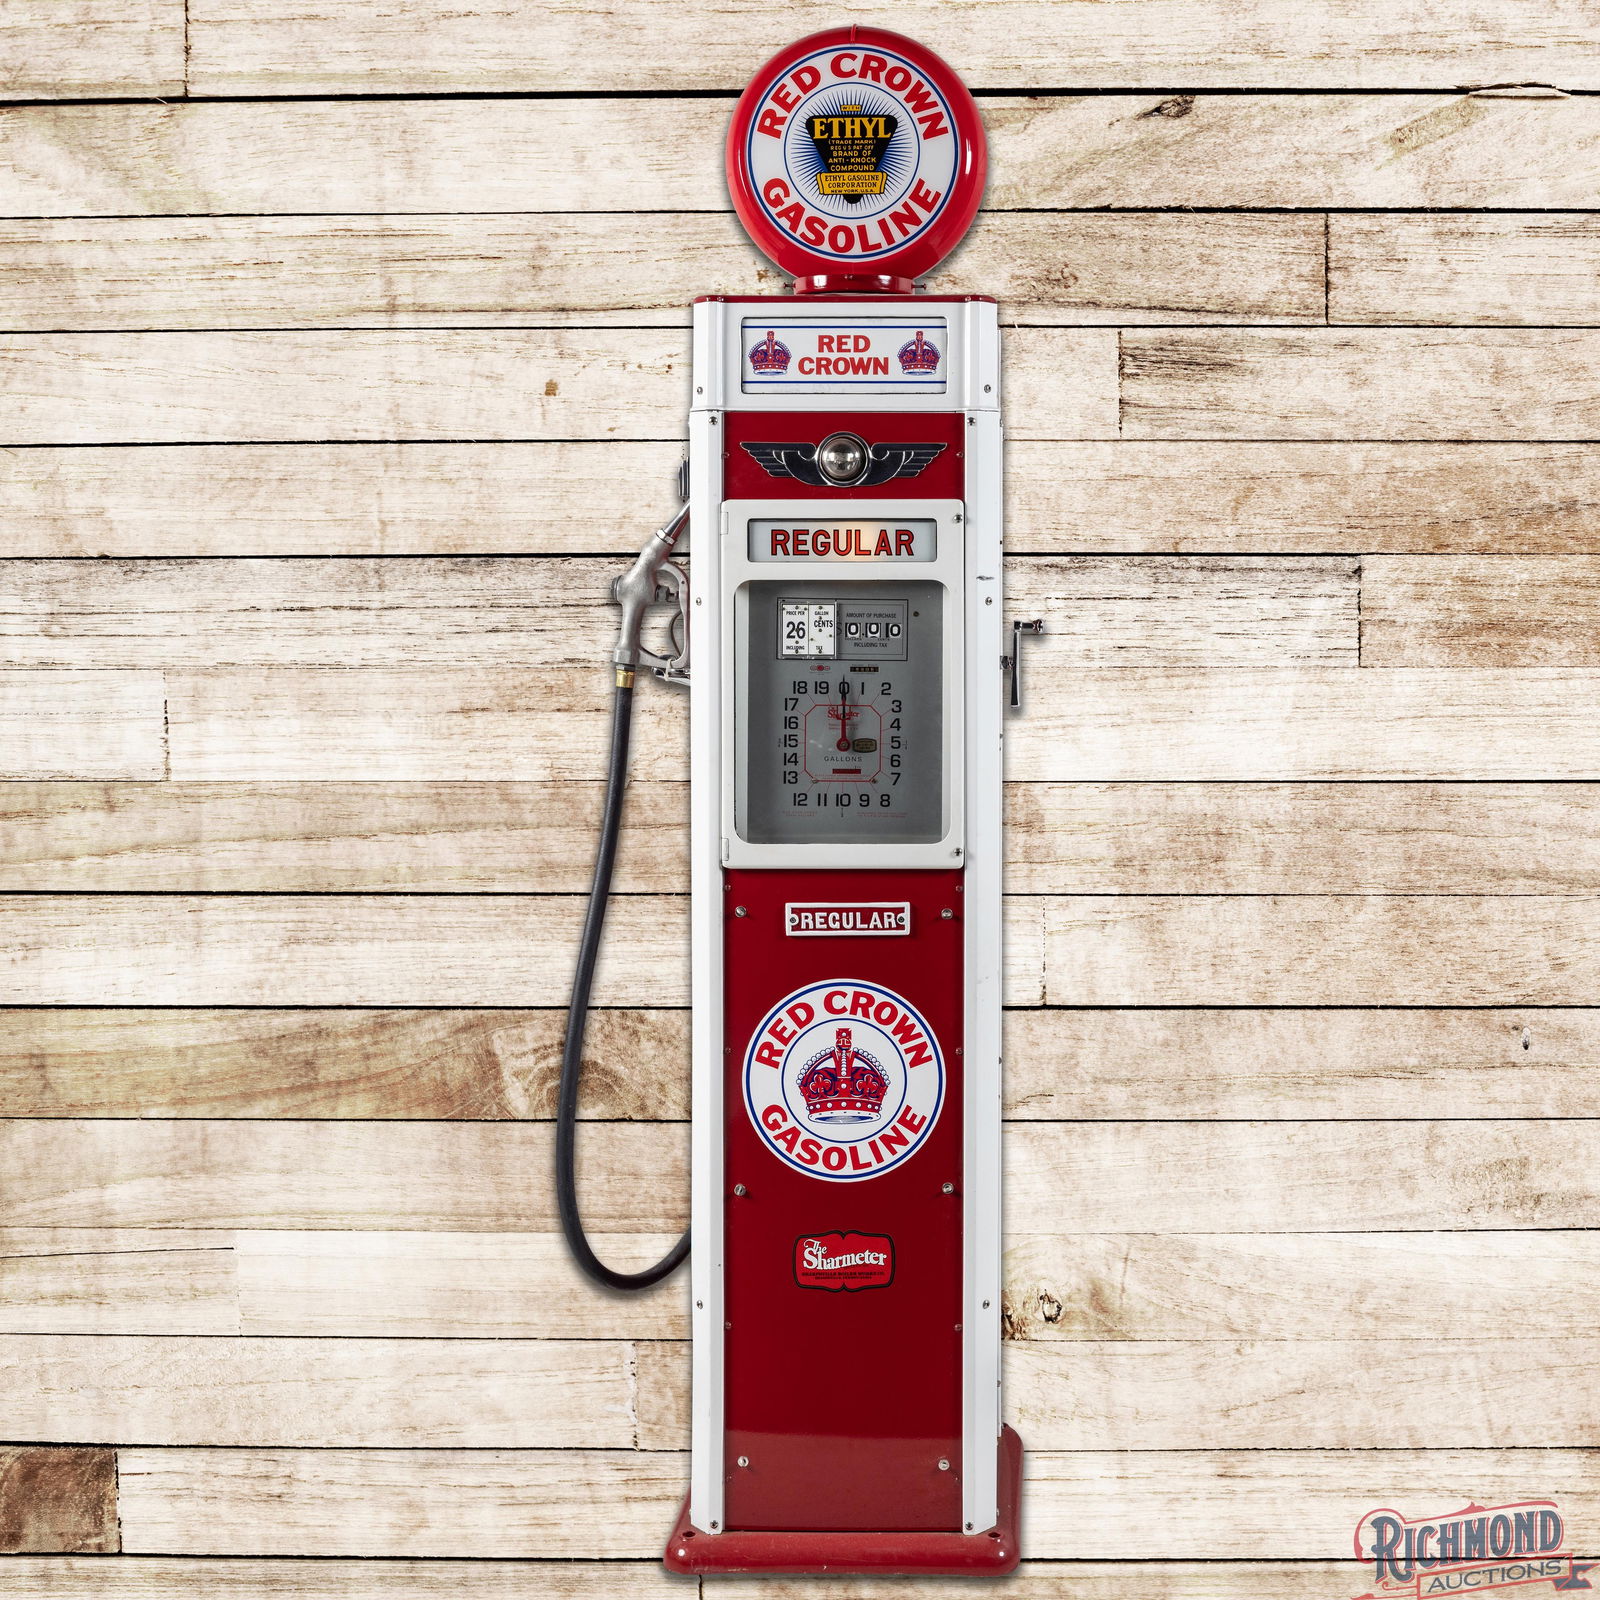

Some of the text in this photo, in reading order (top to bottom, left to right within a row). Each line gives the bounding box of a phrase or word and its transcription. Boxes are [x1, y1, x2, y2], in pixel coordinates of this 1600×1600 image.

[757, 52, 949, 140] RED CROWN
[812, 117, 891, 139] ETHYL
[763, 178, 942, 253] GASOLINE
[818, 335, 870, 353] RED
[798, 357, 888, 375] CROWN
[771, 529, 914, 556] REGULAR
[787, 621, 805, 639] 26
[792, 681, 808, 695] 18
[814, 681, 829, 694] 19
[861, 682, 864, 695] 1
[881, 682, 892, 695] 2
[784, 698, 799, 711] 17
[891, 700, 902, 713] 3
[784, 716, 798, 729] 16
[890, 718, 901, 731] 4
[784, 734, 798, 747] 15
[891, 736, 901, 749] 5
[784, 752, 798, 766] 14
[890, 754, 901, 767] 6
[783, 771, 798, 784] 13
[891, 773, 902, 785] 7
[793, 793, 890, 807] 12 11 10 9 8
[800, 912, 897, 929] REGULAR
[754, 990, 933, 1069] RED CROWN
[761, 1104, 927, 1171] GASOLINE
[804, 1239, 827, 1254] The
[803, 1248, 887, 1270] Sharmeter
